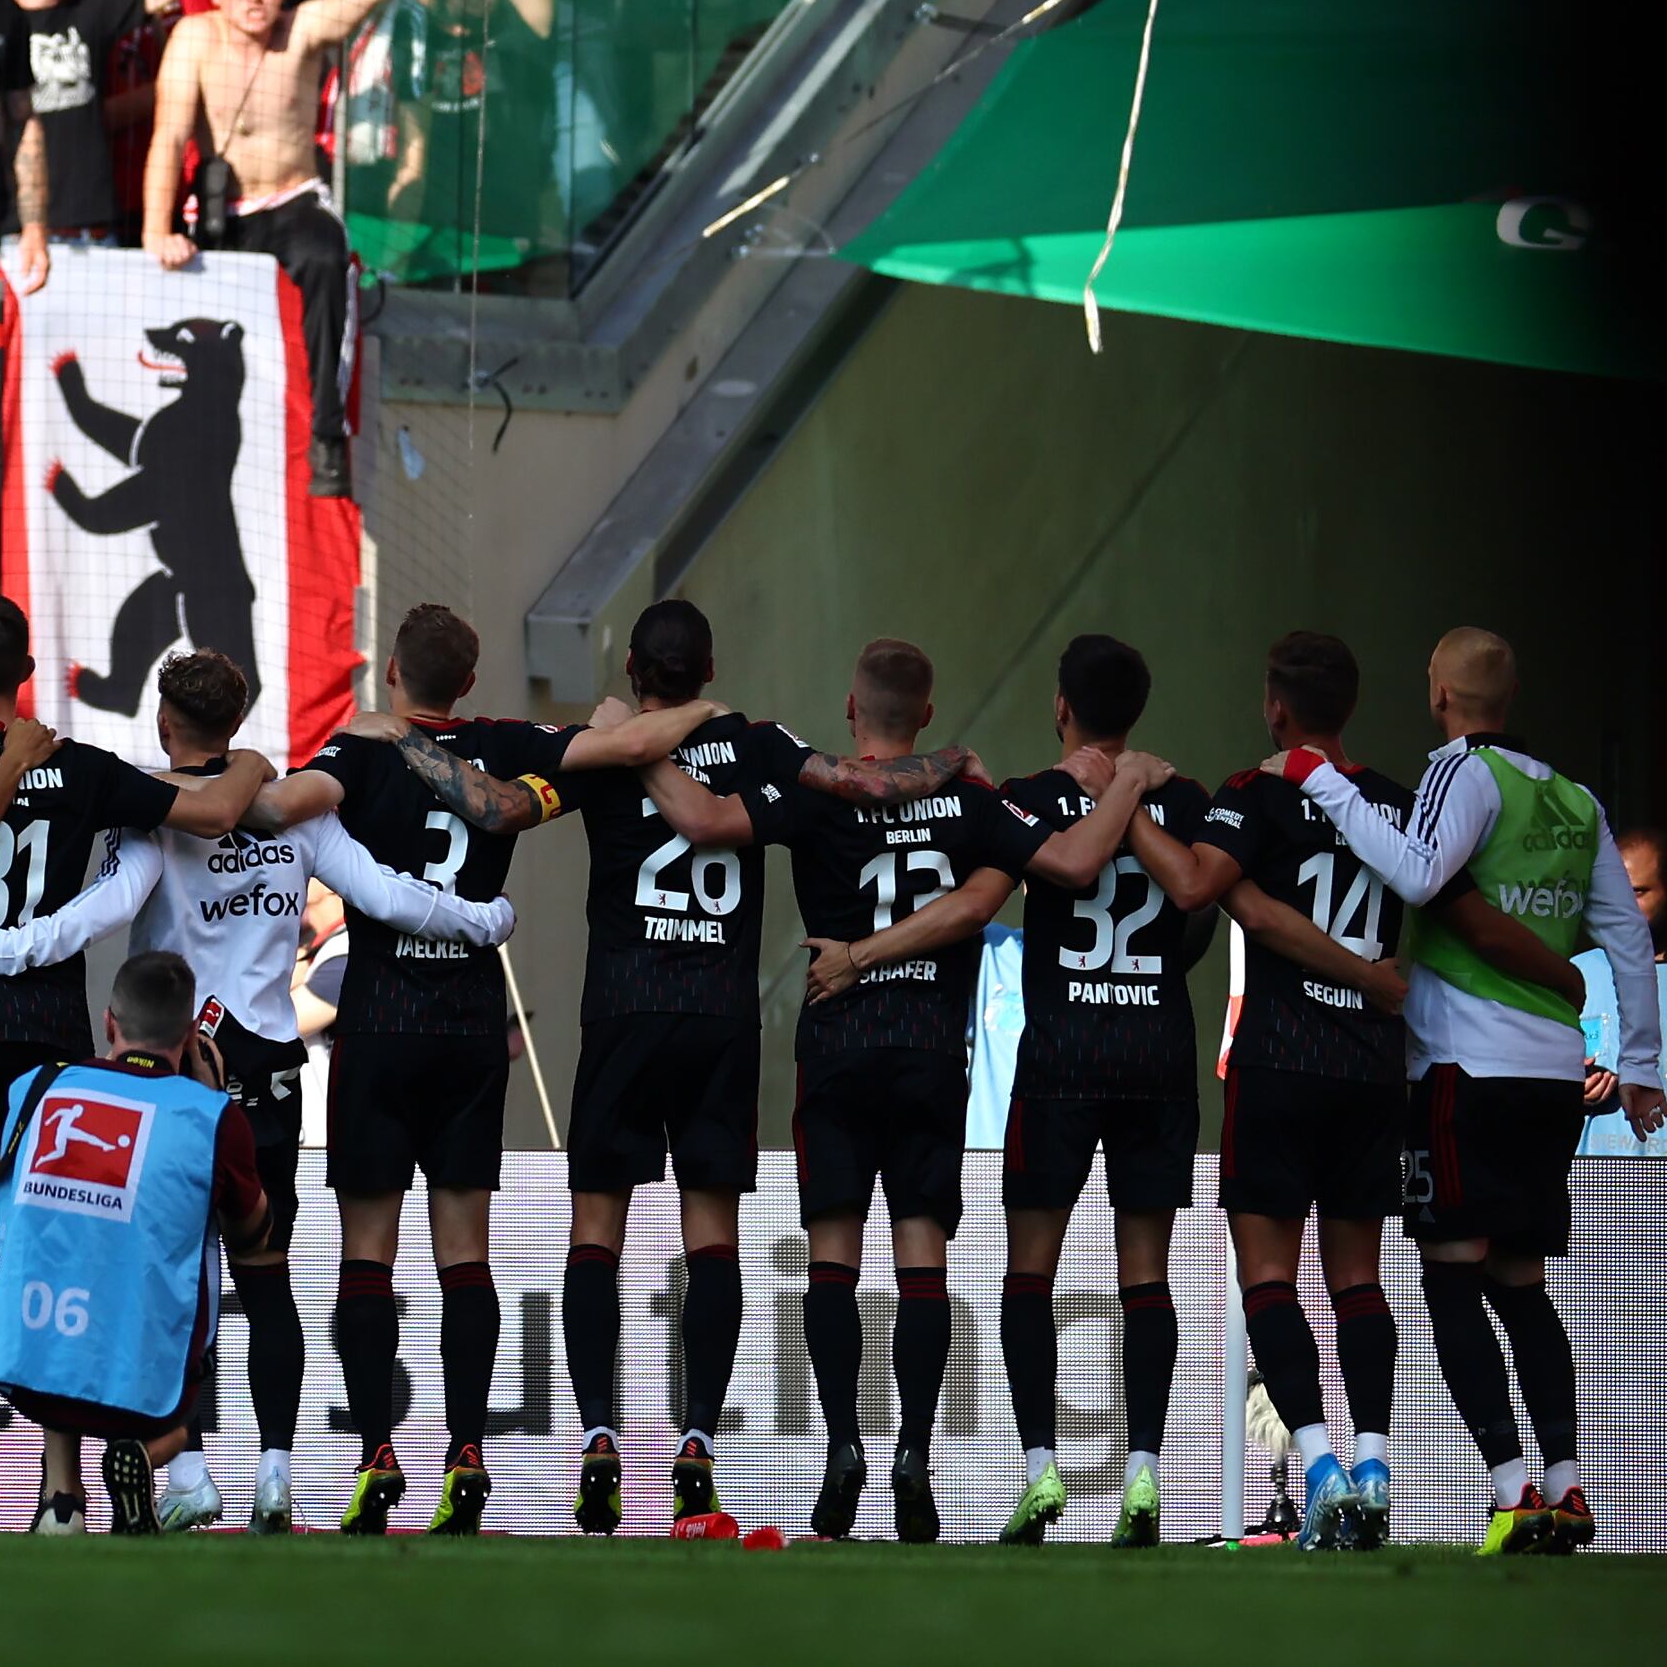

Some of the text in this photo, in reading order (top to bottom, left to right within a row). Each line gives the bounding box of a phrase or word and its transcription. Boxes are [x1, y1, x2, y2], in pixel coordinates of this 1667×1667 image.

[899, 796, 963, 823] UNION
[886, 827, 932, 845] BERLIN
[207, 840, 295, 874] adidas
[422, 811, 470, 896] 3
[201, 882, 301, 921] wefox
[1058, 855, 1166, 975] 32
[1297, 851, 1384, 963] 14
[644, 916, 727, 945] TRIMMEL
[1068, 982, 1160, 1007] PANTOVIC
[1303, 981, 1364, 1010] SEGUIN
[126, 1056, 155, 1069] Nikon
[23, 1181, 124, 1211] BUNDESLIGA
[21, 1280, 91, 1337] 06
